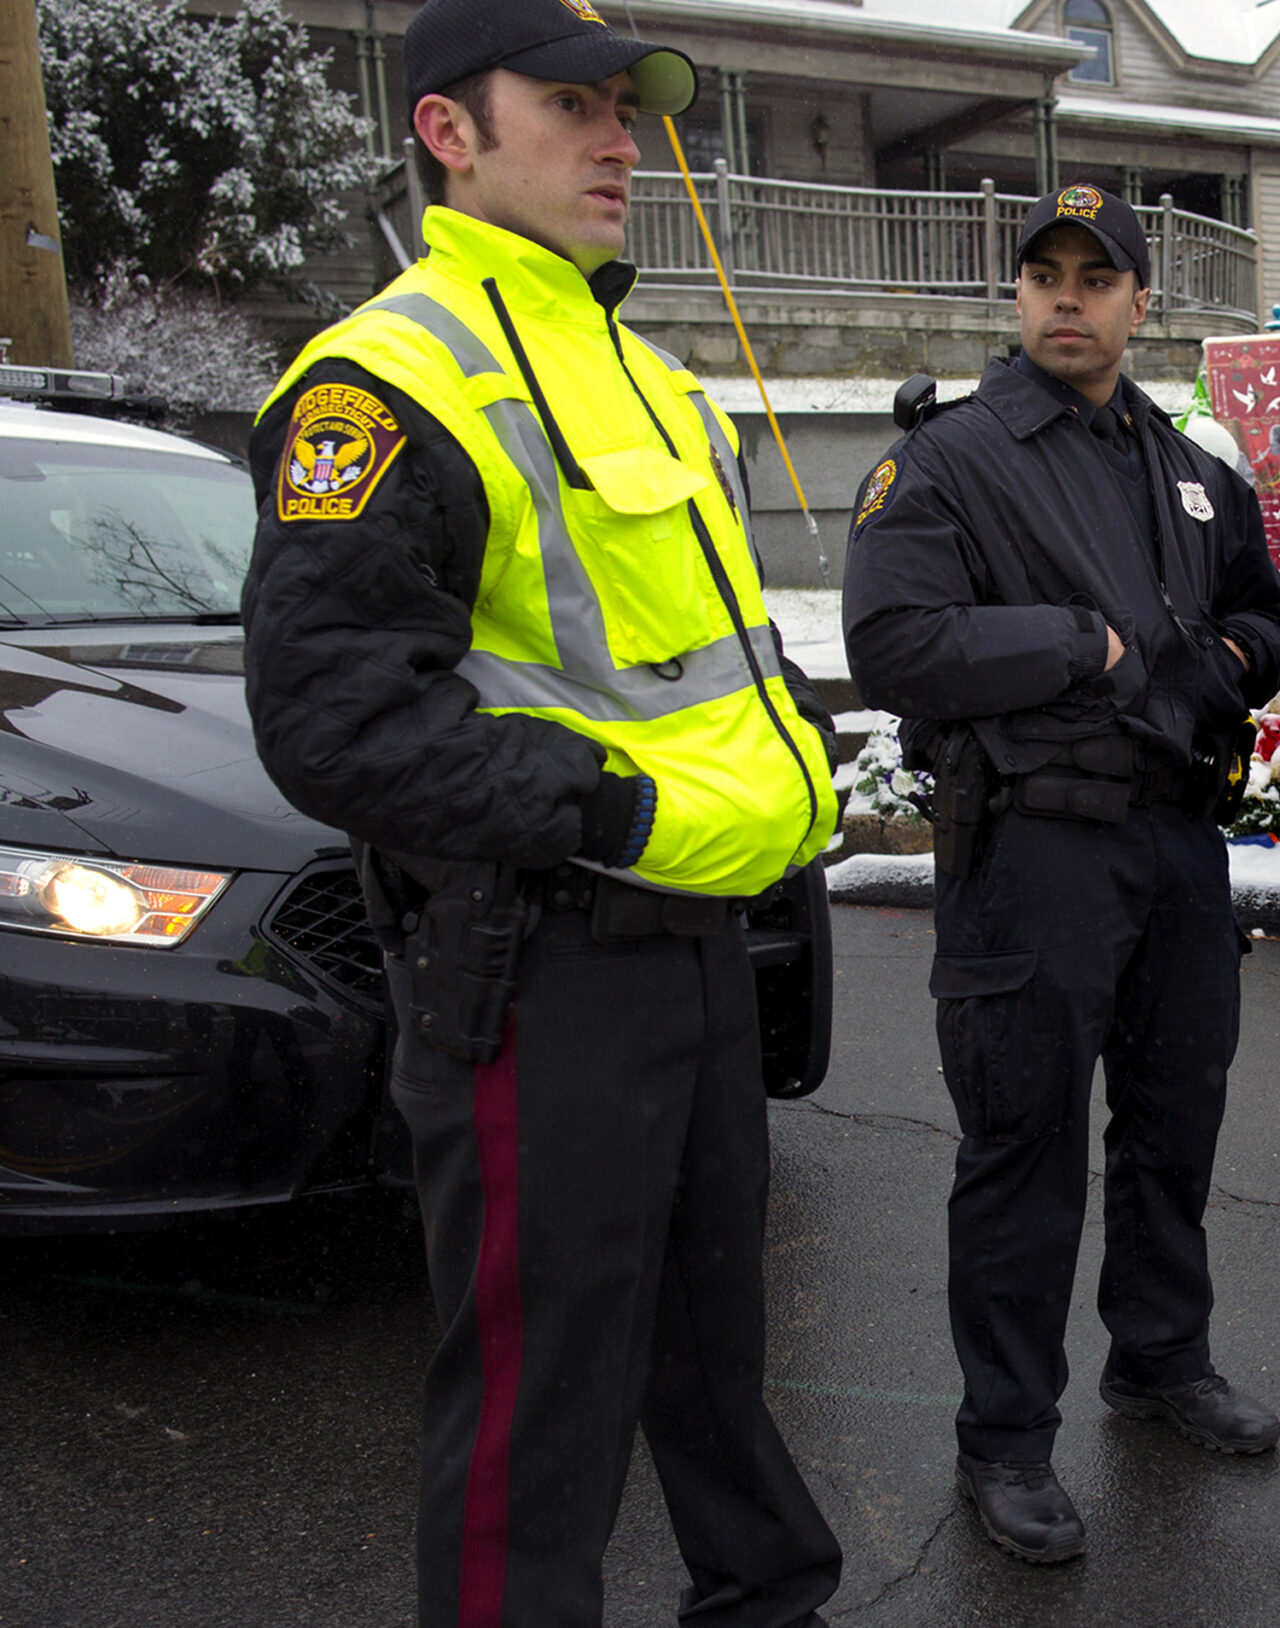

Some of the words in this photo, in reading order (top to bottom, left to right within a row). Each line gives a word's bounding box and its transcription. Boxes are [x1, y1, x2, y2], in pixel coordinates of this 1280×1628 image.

[1056, 206, 1098, 220] POLICE
[301, 404, 377, 429] CONNECTICUT
[286, 498, 353, 515] POLICE
